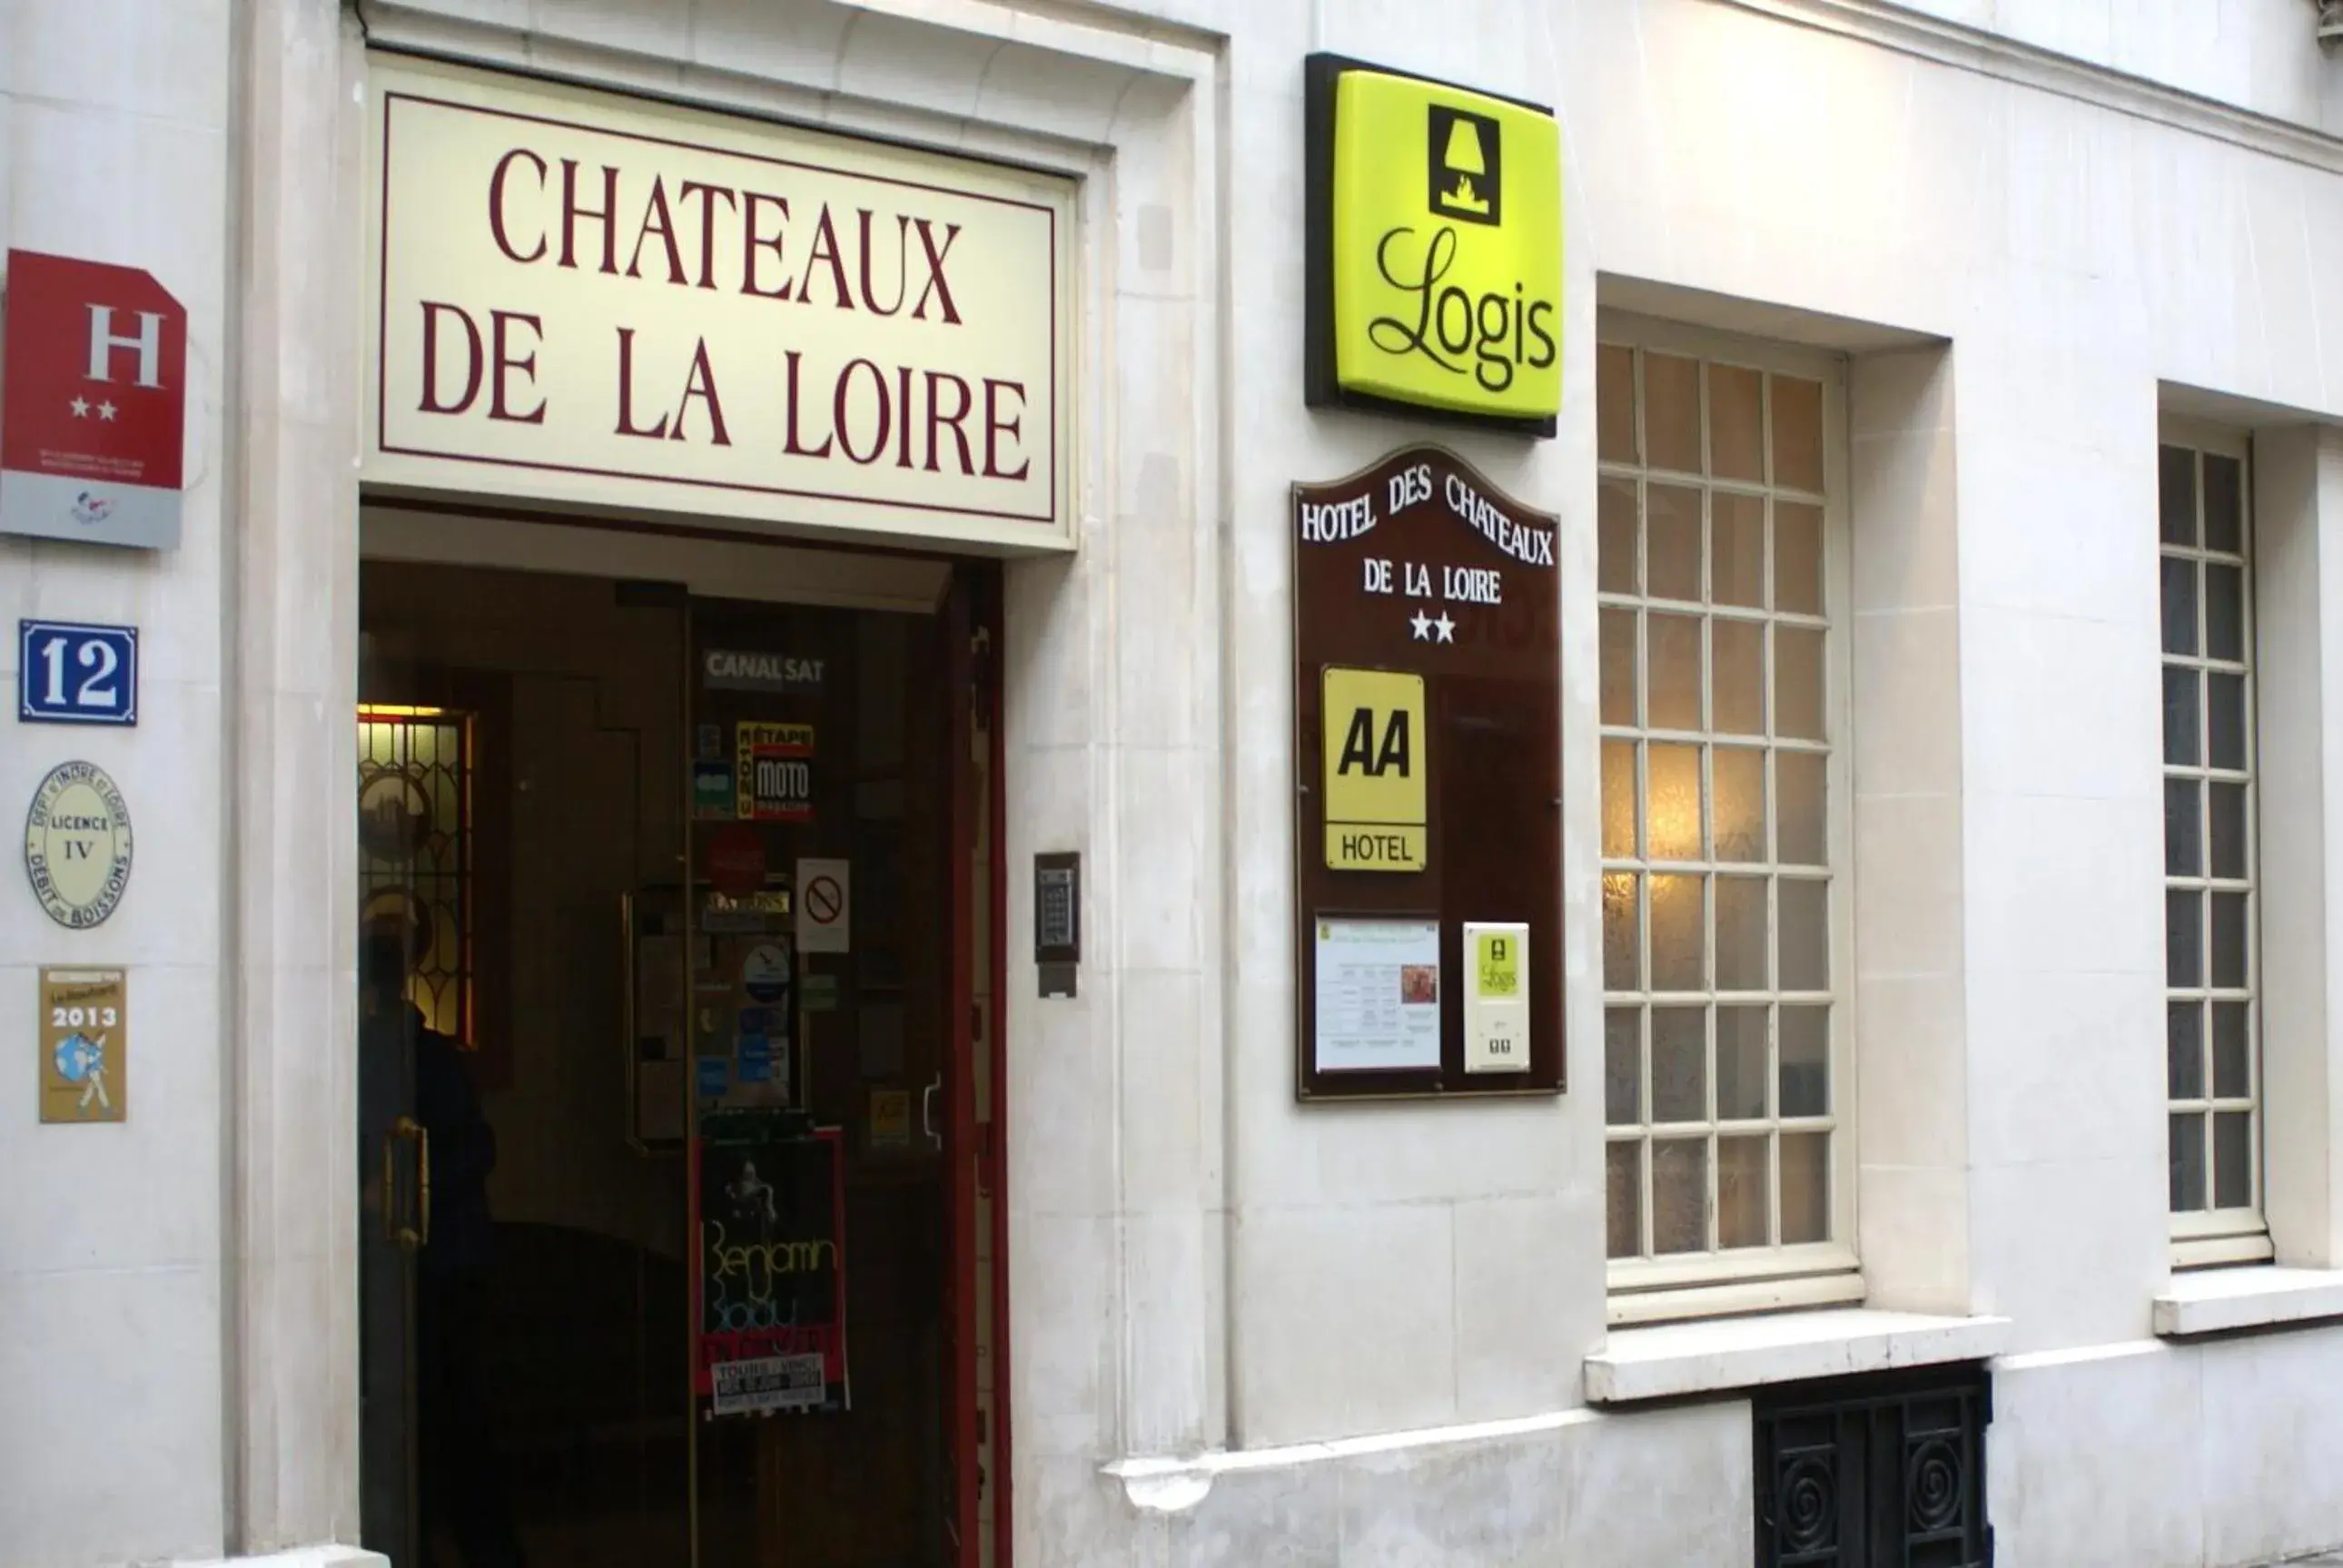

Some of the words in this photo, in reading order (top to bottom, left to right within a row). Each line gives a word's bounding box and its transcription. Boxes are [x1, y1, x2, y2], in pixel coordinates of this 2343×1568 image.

[489, 147, 963, 325] CHATEAUX
[1368, 226, 1556, 392] Logis
[83, 302, 168, 390] H
[417, 300, 547, 425] DE
[614, 327, 732, 447] LA
[783, 350, 1032, 481] LOIRE
[1301, 493, 1377, 542] HOTEL
[1389, 464, 1433, 516] DES
[1445, 473, 1554, 567] CHATEAUX
[1363, 557, 1393, 593] DE
[1405, 562, 1432, 597] LA
[1443, 566, 1502, 604] LOIRE
[42, 637, 118, 706] 12
[1337, 706, 1410, 778] AA
[756, 759, 810, 799] MOTO
[51, 817, 108, 832] LICENCE
[64, 841, 94, 860] IV
[1342, 833, 1413, 862] HOTEL
[52, 1006, 116, 1027] 2013
